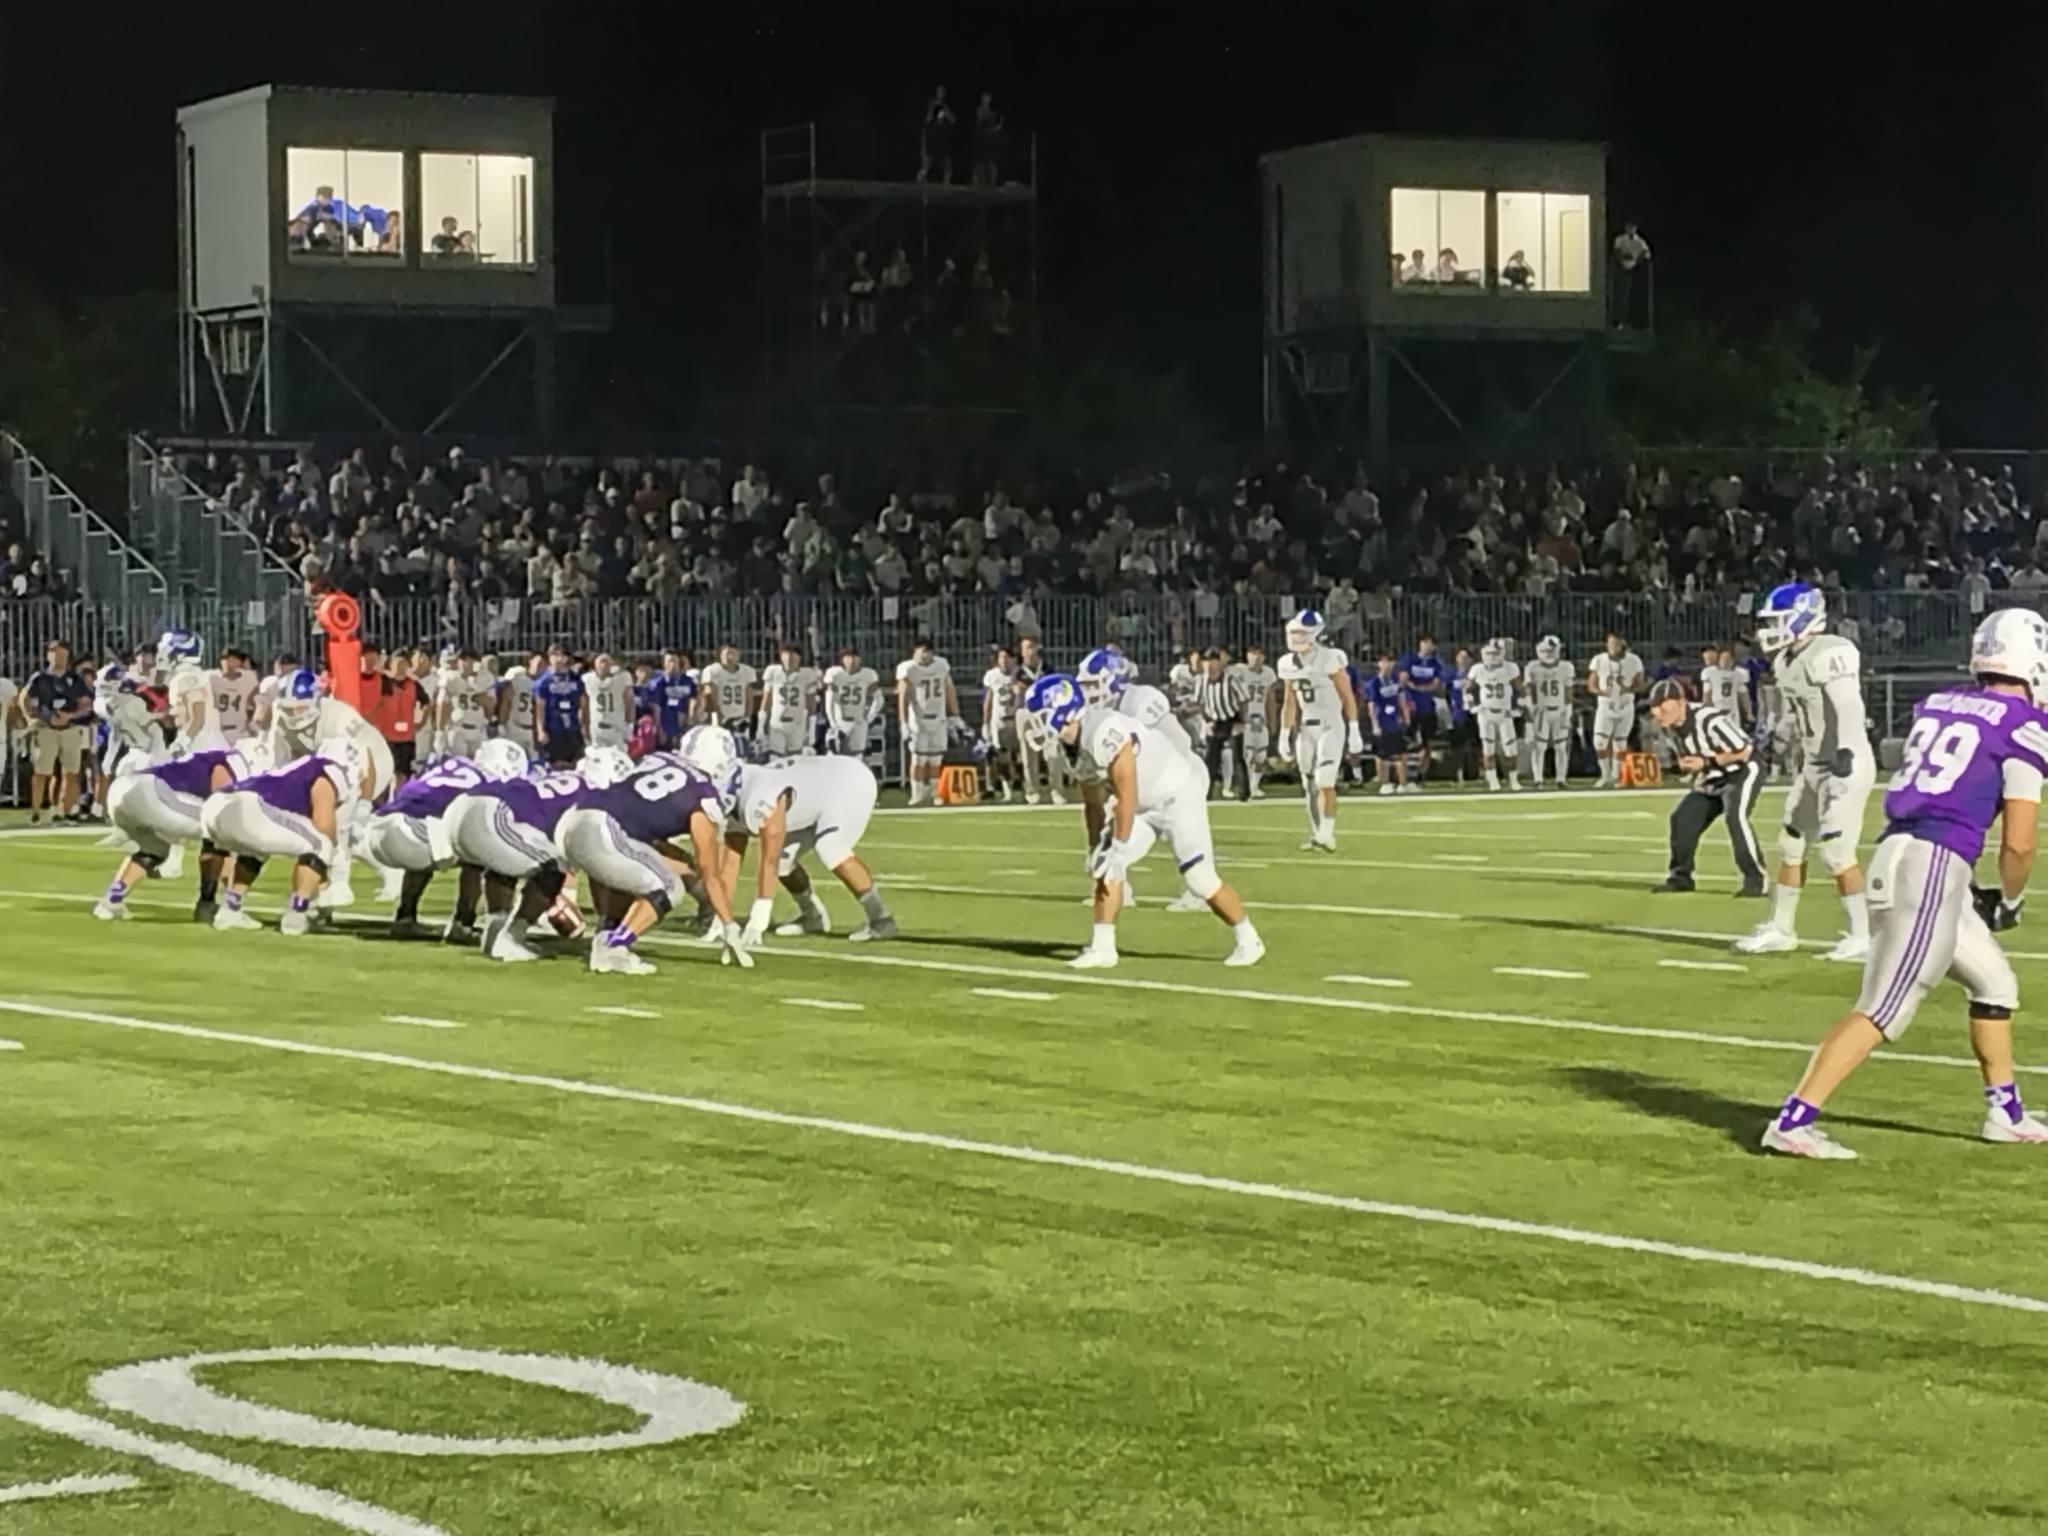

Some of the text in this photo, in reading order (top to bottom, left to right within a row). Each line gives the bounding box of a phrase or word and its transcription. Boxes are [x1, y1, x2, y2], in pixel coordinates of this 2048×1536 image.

[1829, 655, 1848, 672] 41
[218, 693, 241, 713] 94
[597, 692, 614, 712] 91
[839, 686, 862, 708] 25
[1887, 716, 1981, 795] 89
[1632, 754, 1659, 787] 50
[951, 769, 977, 799] 40
[88, 1345, 747, 1455] 0
